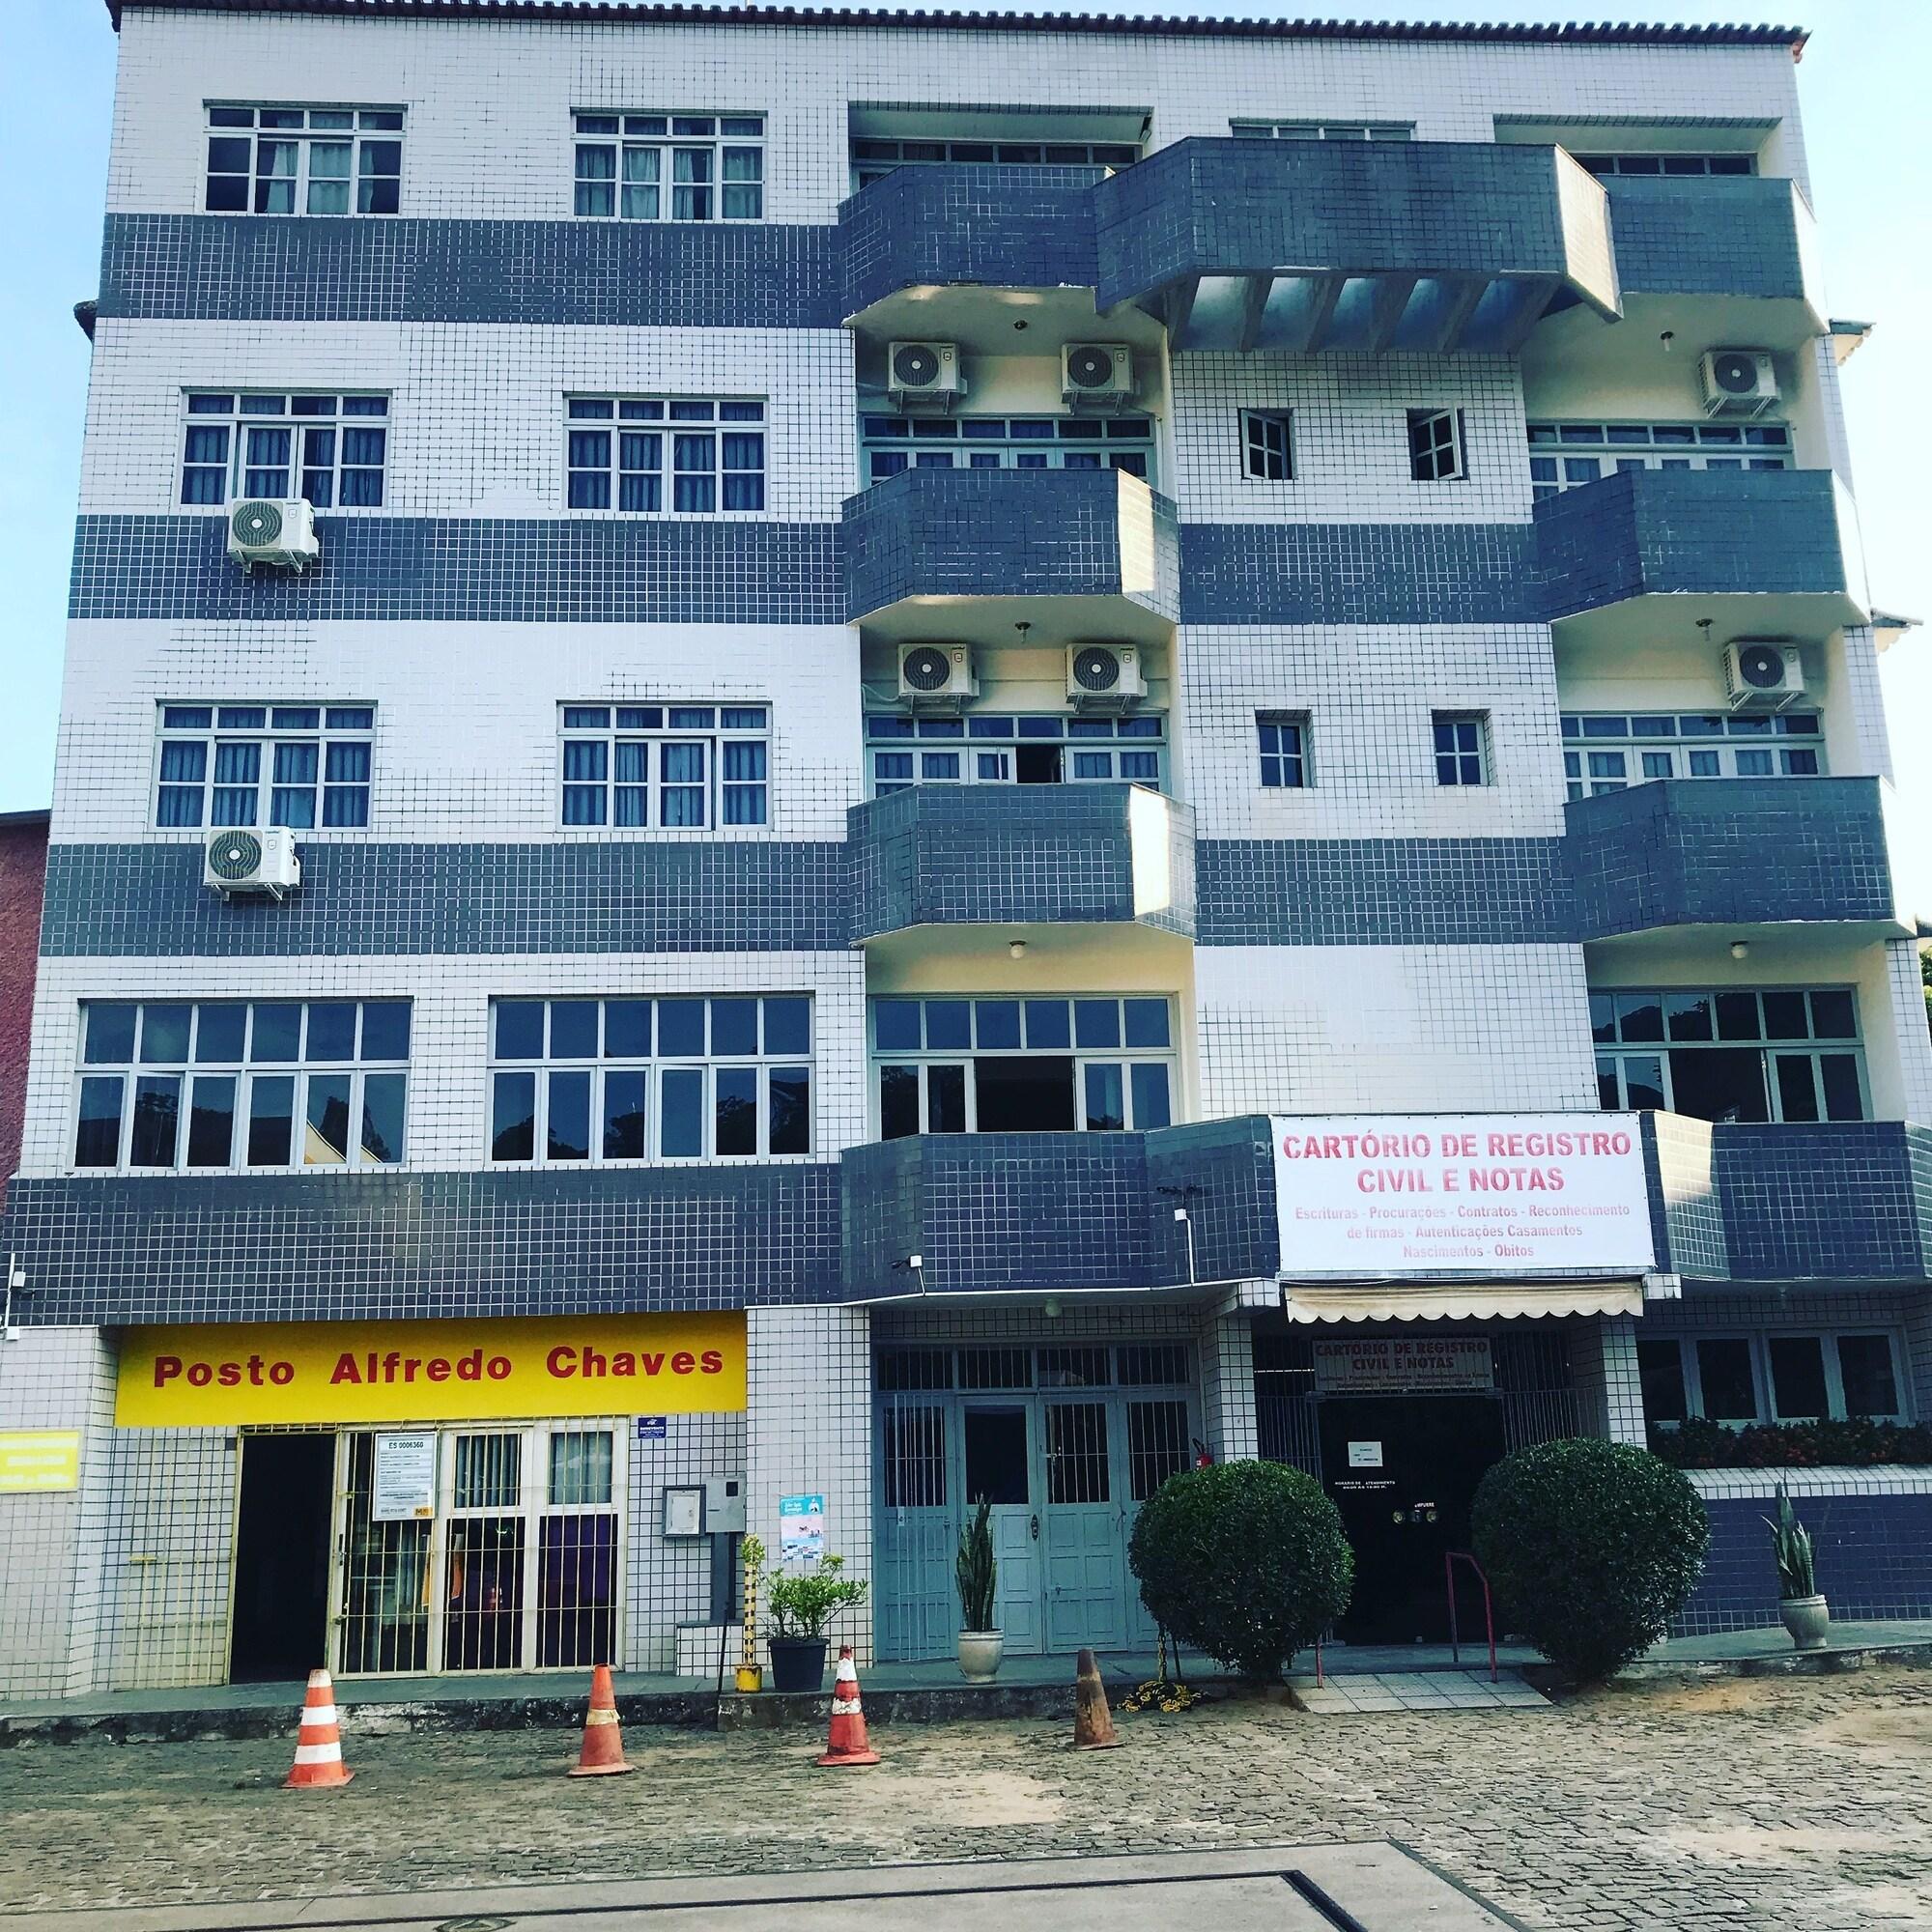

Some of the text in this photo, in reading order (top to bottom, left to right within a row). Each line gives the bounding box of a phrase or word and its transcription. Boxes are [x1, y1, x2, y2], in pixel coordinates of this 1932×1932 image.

[1283, 1129, 1632, 1159] CARTÓRIO DE REGISTRO
[1357, 1166, 1565, 1193] CIVIL E NOTAS
[1294, 1207, 1359, 1220] Escrituras
[1457, 1205, 1519, 1218] Contratos
[1529, 1204, 1631, 1217] Reconhecimento
[1348, 1226, 1362, 1238] de
[1365, 1226, 1405, 1238] firmas
[1415, 1225, 1504, 1240] Autenticações
[1507, 1224, 1583, 1236] Casamentos
[1403, 1245, 1484, 1259] Nascimentos
[1394, 1343, 1411, 1354] DE
[1416, 1342, 1488, 1354] REGISTRO
[154, 1345, 724, 1388] Posto Alfredo Chaves
[1352, 1357, 1455, 1370] CIVIL E NOTAS
